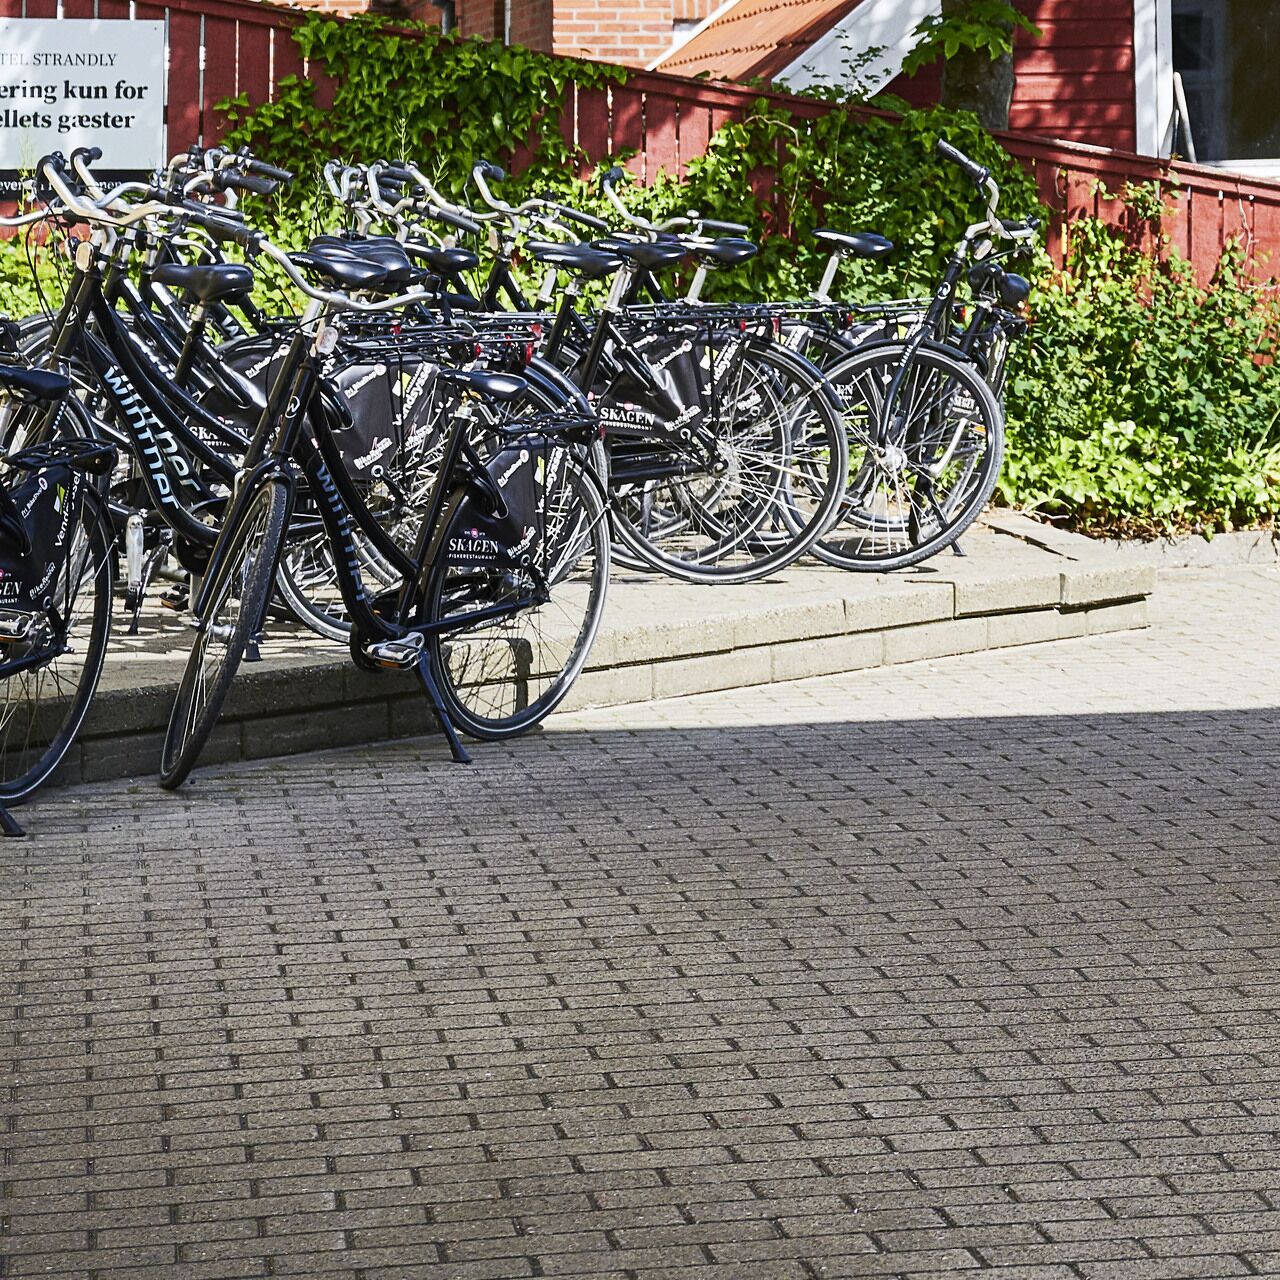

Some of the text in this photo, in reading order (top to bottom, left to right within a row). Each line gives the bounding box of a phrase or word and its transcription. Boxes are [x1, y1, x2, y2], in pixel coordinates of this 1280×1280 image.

[33, 53, 117, 66] STRANDLY
[0, 80, 148, 104] ering kun for
[0, 109, 135, 133] llets gæster
[448, 538, 500, 554] SKAGEN
